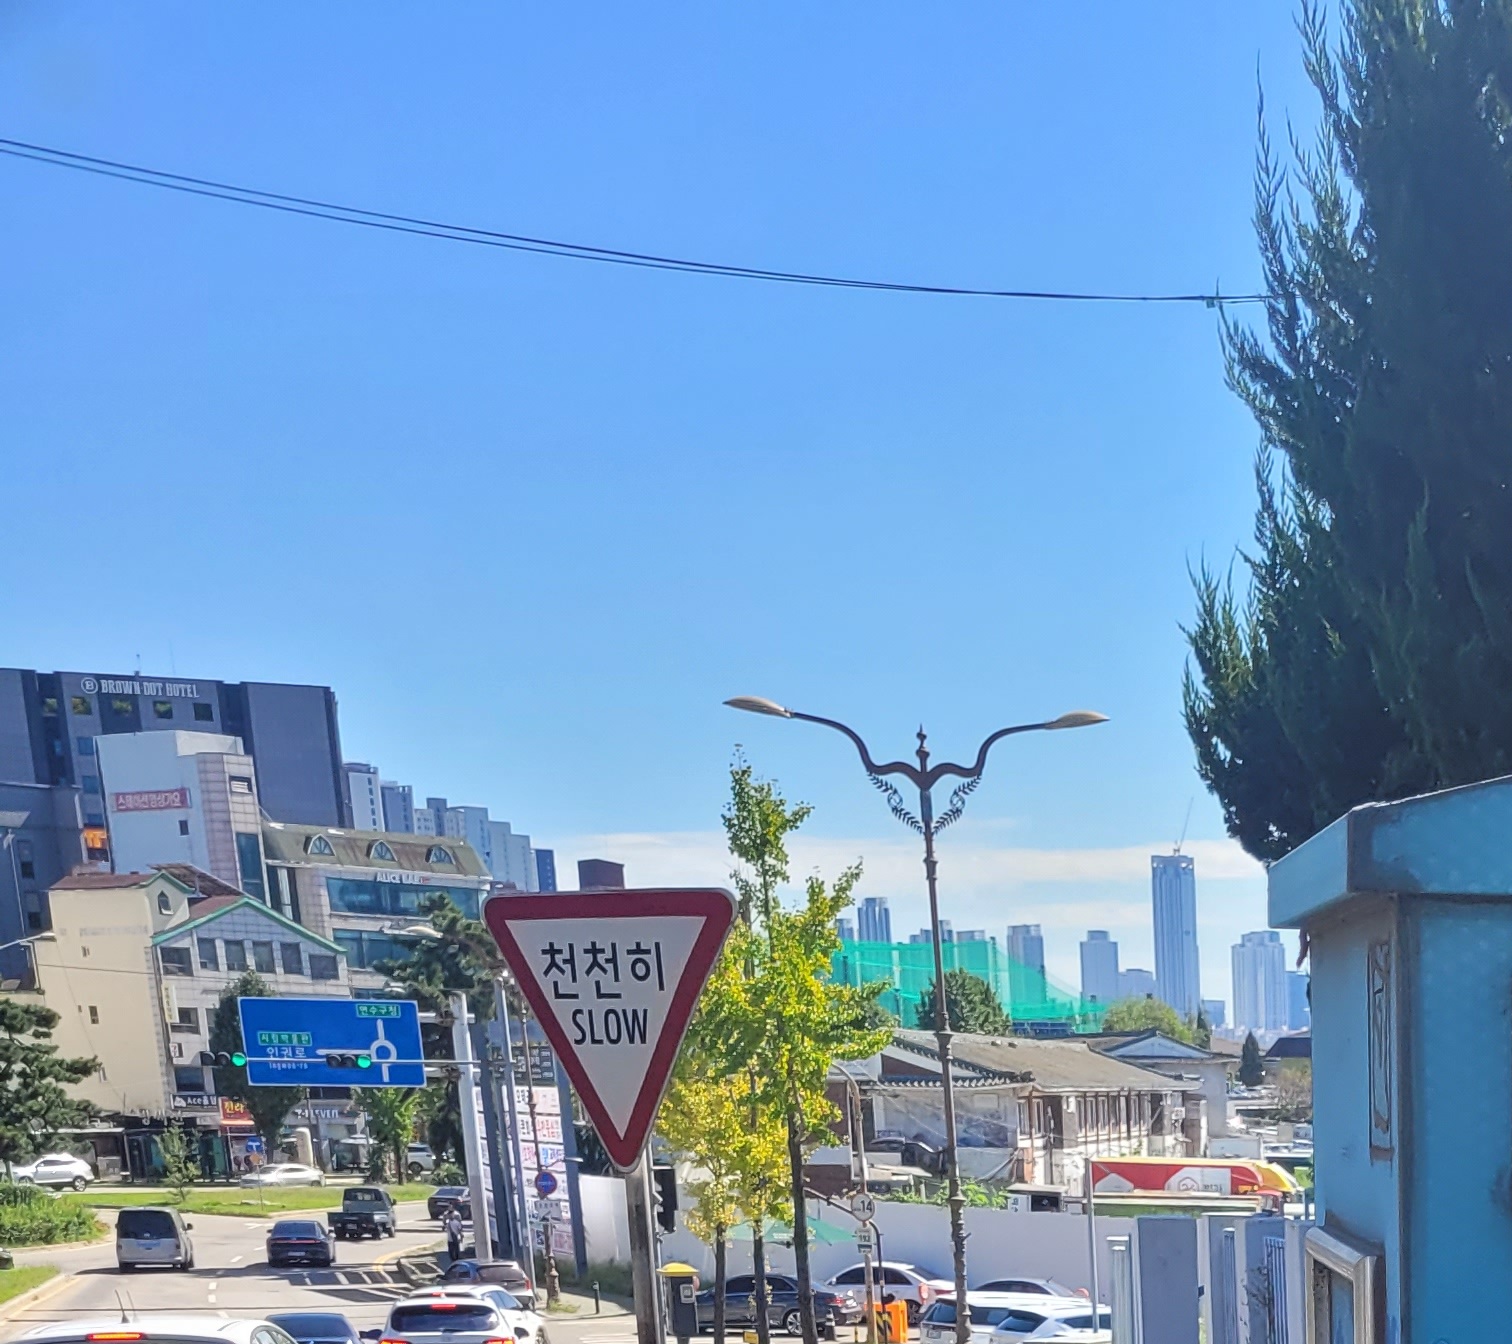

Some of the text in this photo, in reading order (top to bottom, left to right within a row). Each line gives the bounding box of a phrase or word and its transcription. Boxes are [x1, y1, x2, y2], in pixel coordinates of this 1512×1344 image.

[100, 679, 200, 698] BROWN DOT HOTEL
[541, 941, 665, 1000] 천천히
[358, 1005, 397, 1017] 연수구청
[571, 1008, 649, 1045] SLOW
